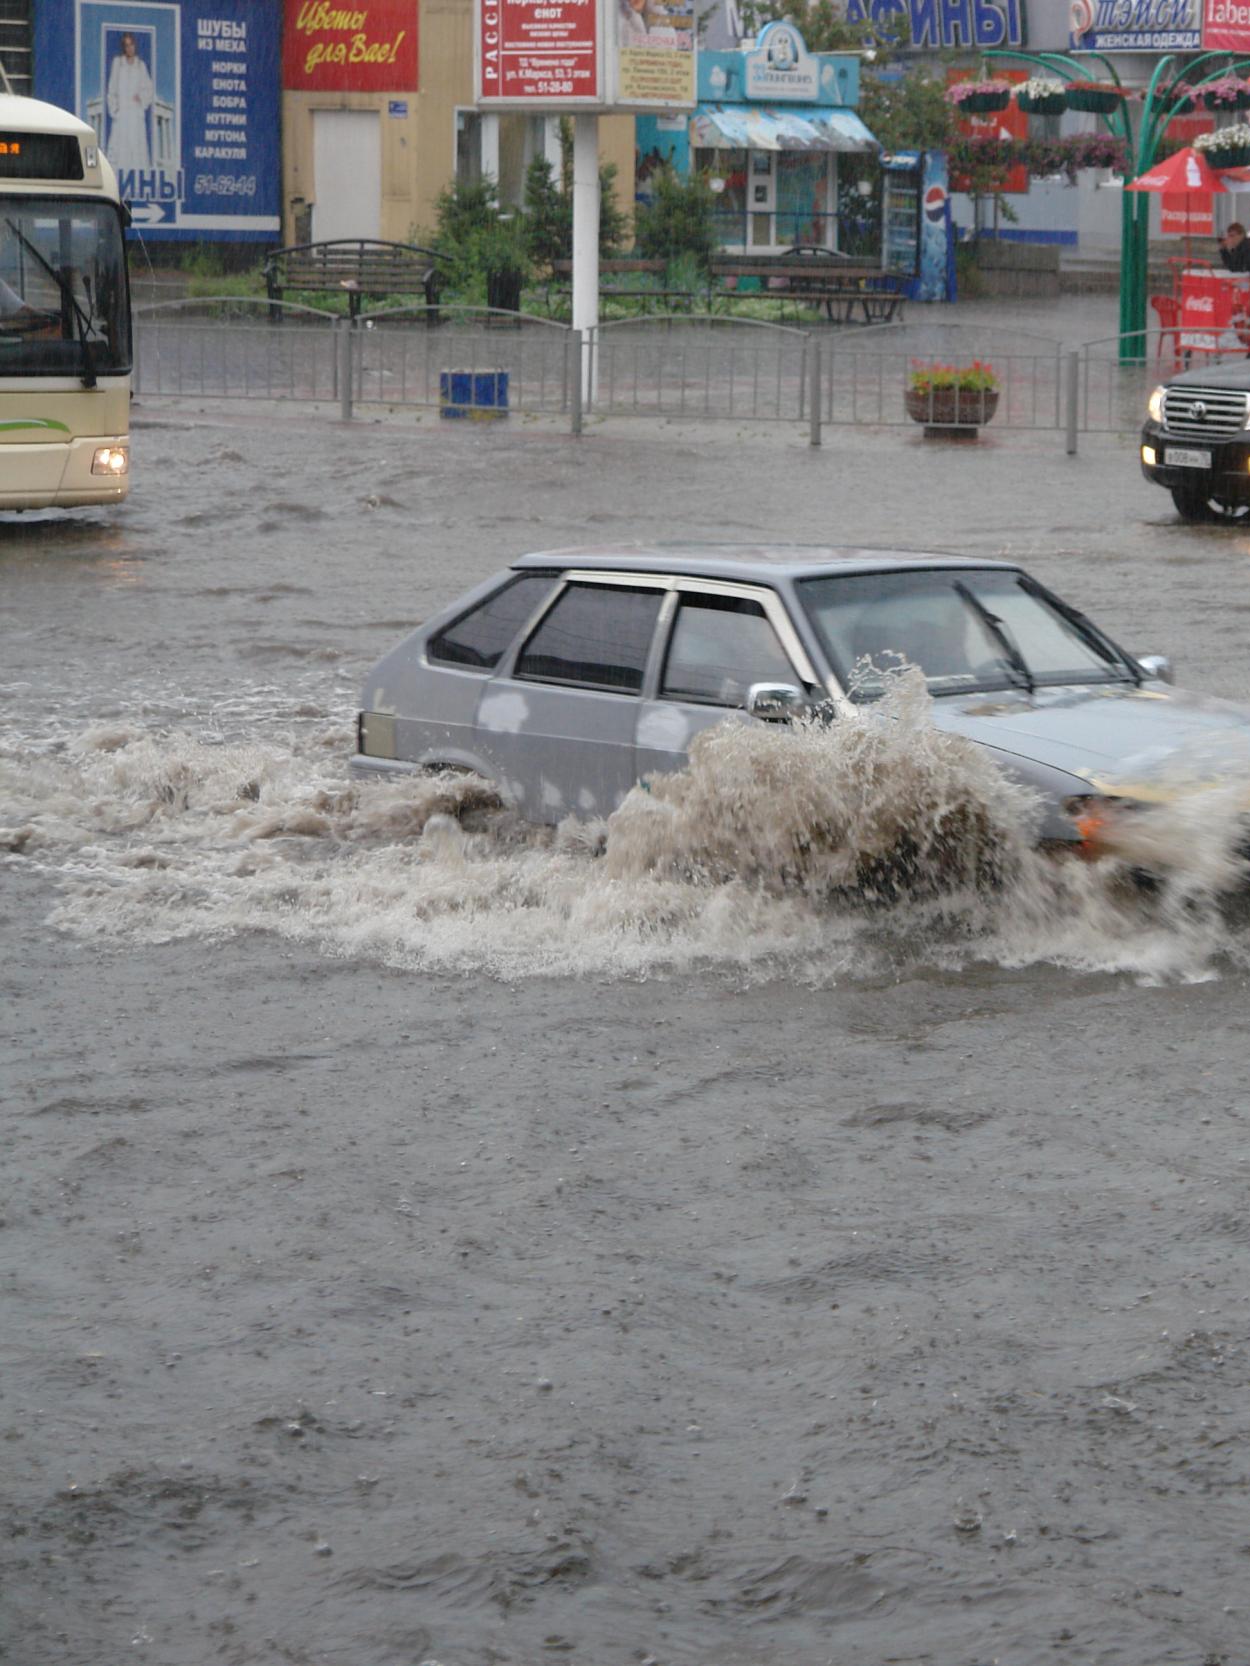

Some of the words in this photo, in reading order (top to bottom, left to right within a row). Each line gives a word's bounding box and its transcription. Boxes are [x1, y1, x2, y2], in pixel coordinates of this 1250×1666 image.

[296, 1, 368, 36] Цветы
[197, 19, 247, 38] ШУБЫ
[197, 38, 213, 51] ИЗ
[215, 40, 247, 52] МЕХА
[1095, 32, 1152, 48] ЖЕНСКАЯ
[1152, 31, 1200, 49] ОДЕЖДА
[305, 43, 346, 73] для
[349, 31, 405, 64] Вас!
[212, 61, 247, 74] НОРКИ
[212, 78, 247, 91] ЕНОТА
[213, 96, 247, 109] БОБРА
[206, 113, 247, 126] НУТРИИ
[205, 130, 247, 143] МУТОНА
[195, 147, 247, 160] КАРАКУЛЯ
[118, 168, 186, 201] ИНЫ
